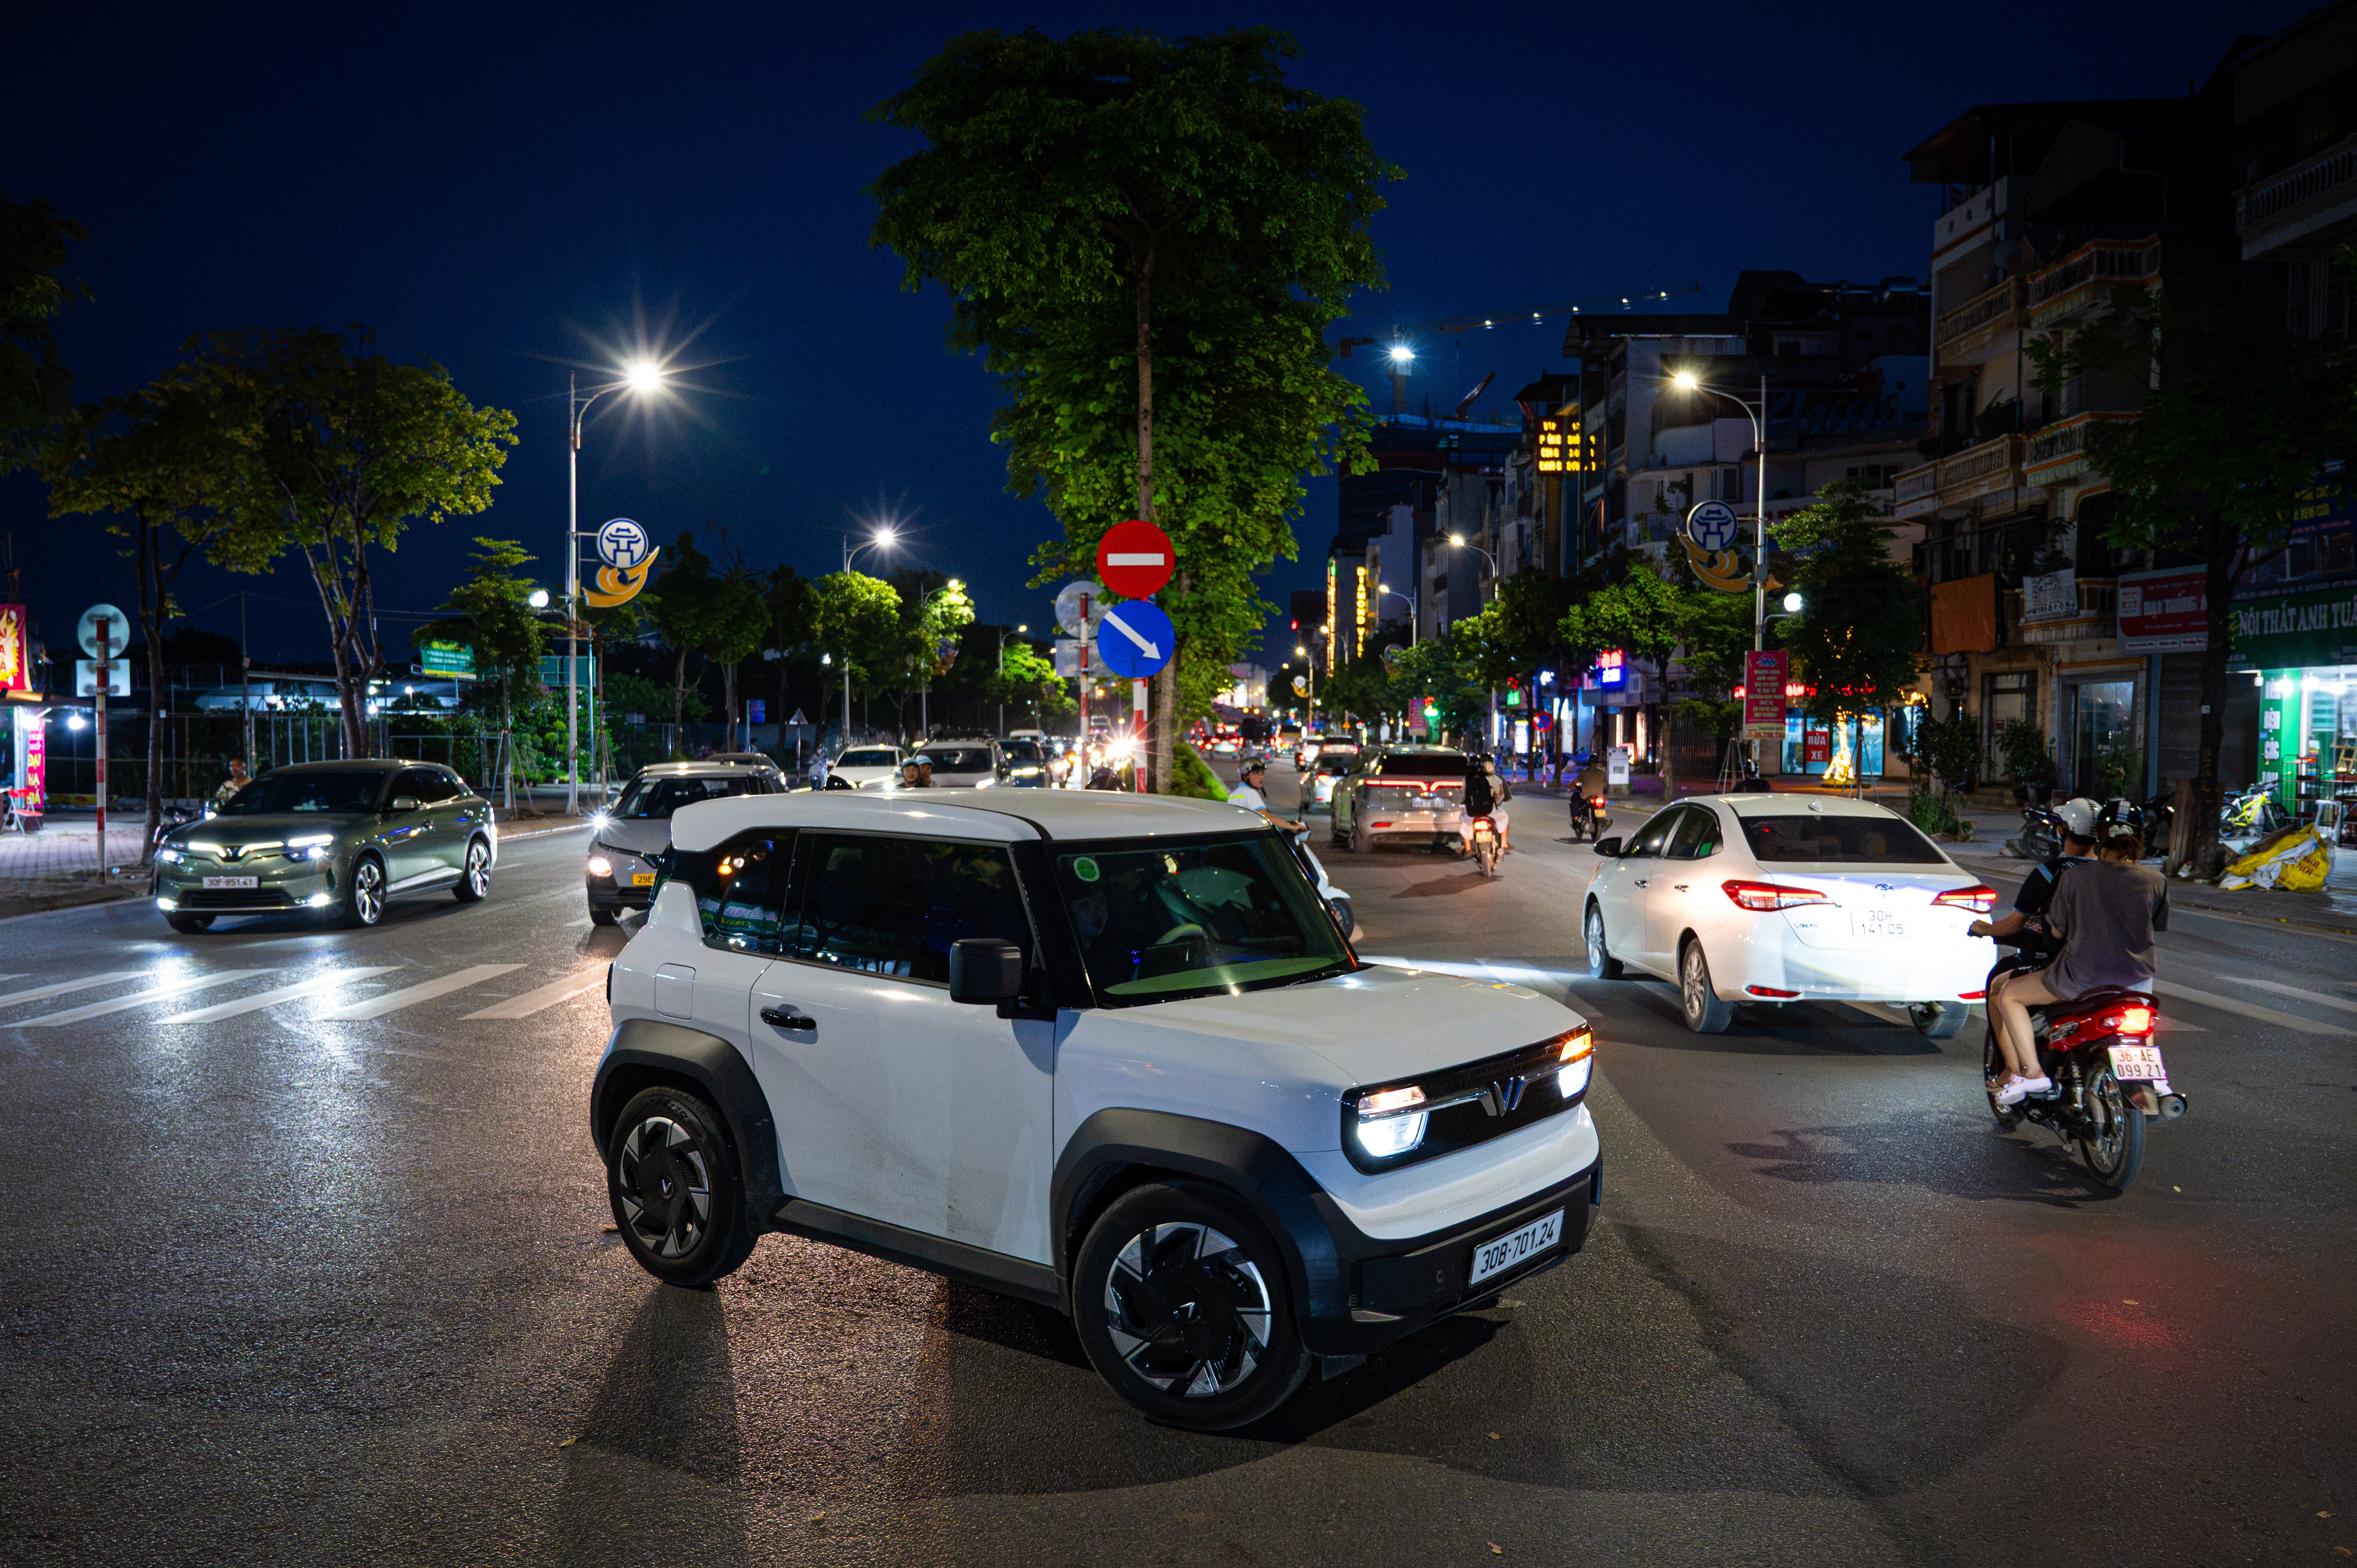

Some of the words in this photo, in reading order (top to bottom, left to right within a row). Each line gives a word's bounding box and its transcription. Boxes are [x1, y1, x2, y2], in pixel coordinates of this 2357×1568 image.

[1356, 566, 1366, 625] DIAMOND
[2239, 607, 2260, 639] NỘI
[2262, 600, 2296, 635] THẤT
[2297, 604, 2328, 631] ANH
[1808, 733, 1825, 745] RỬA
[1811, 750, 1823, 760] XE
[1869, 910, 1892, 921] 30H
[1862, 923, 1904, 934] 141.05
[2118, 1049, 2155, 1062] 36-AE
[2117, 1064, 2162, 1077] 099.21
[1480, 1217, 1556, 1274] 30B-701.24
